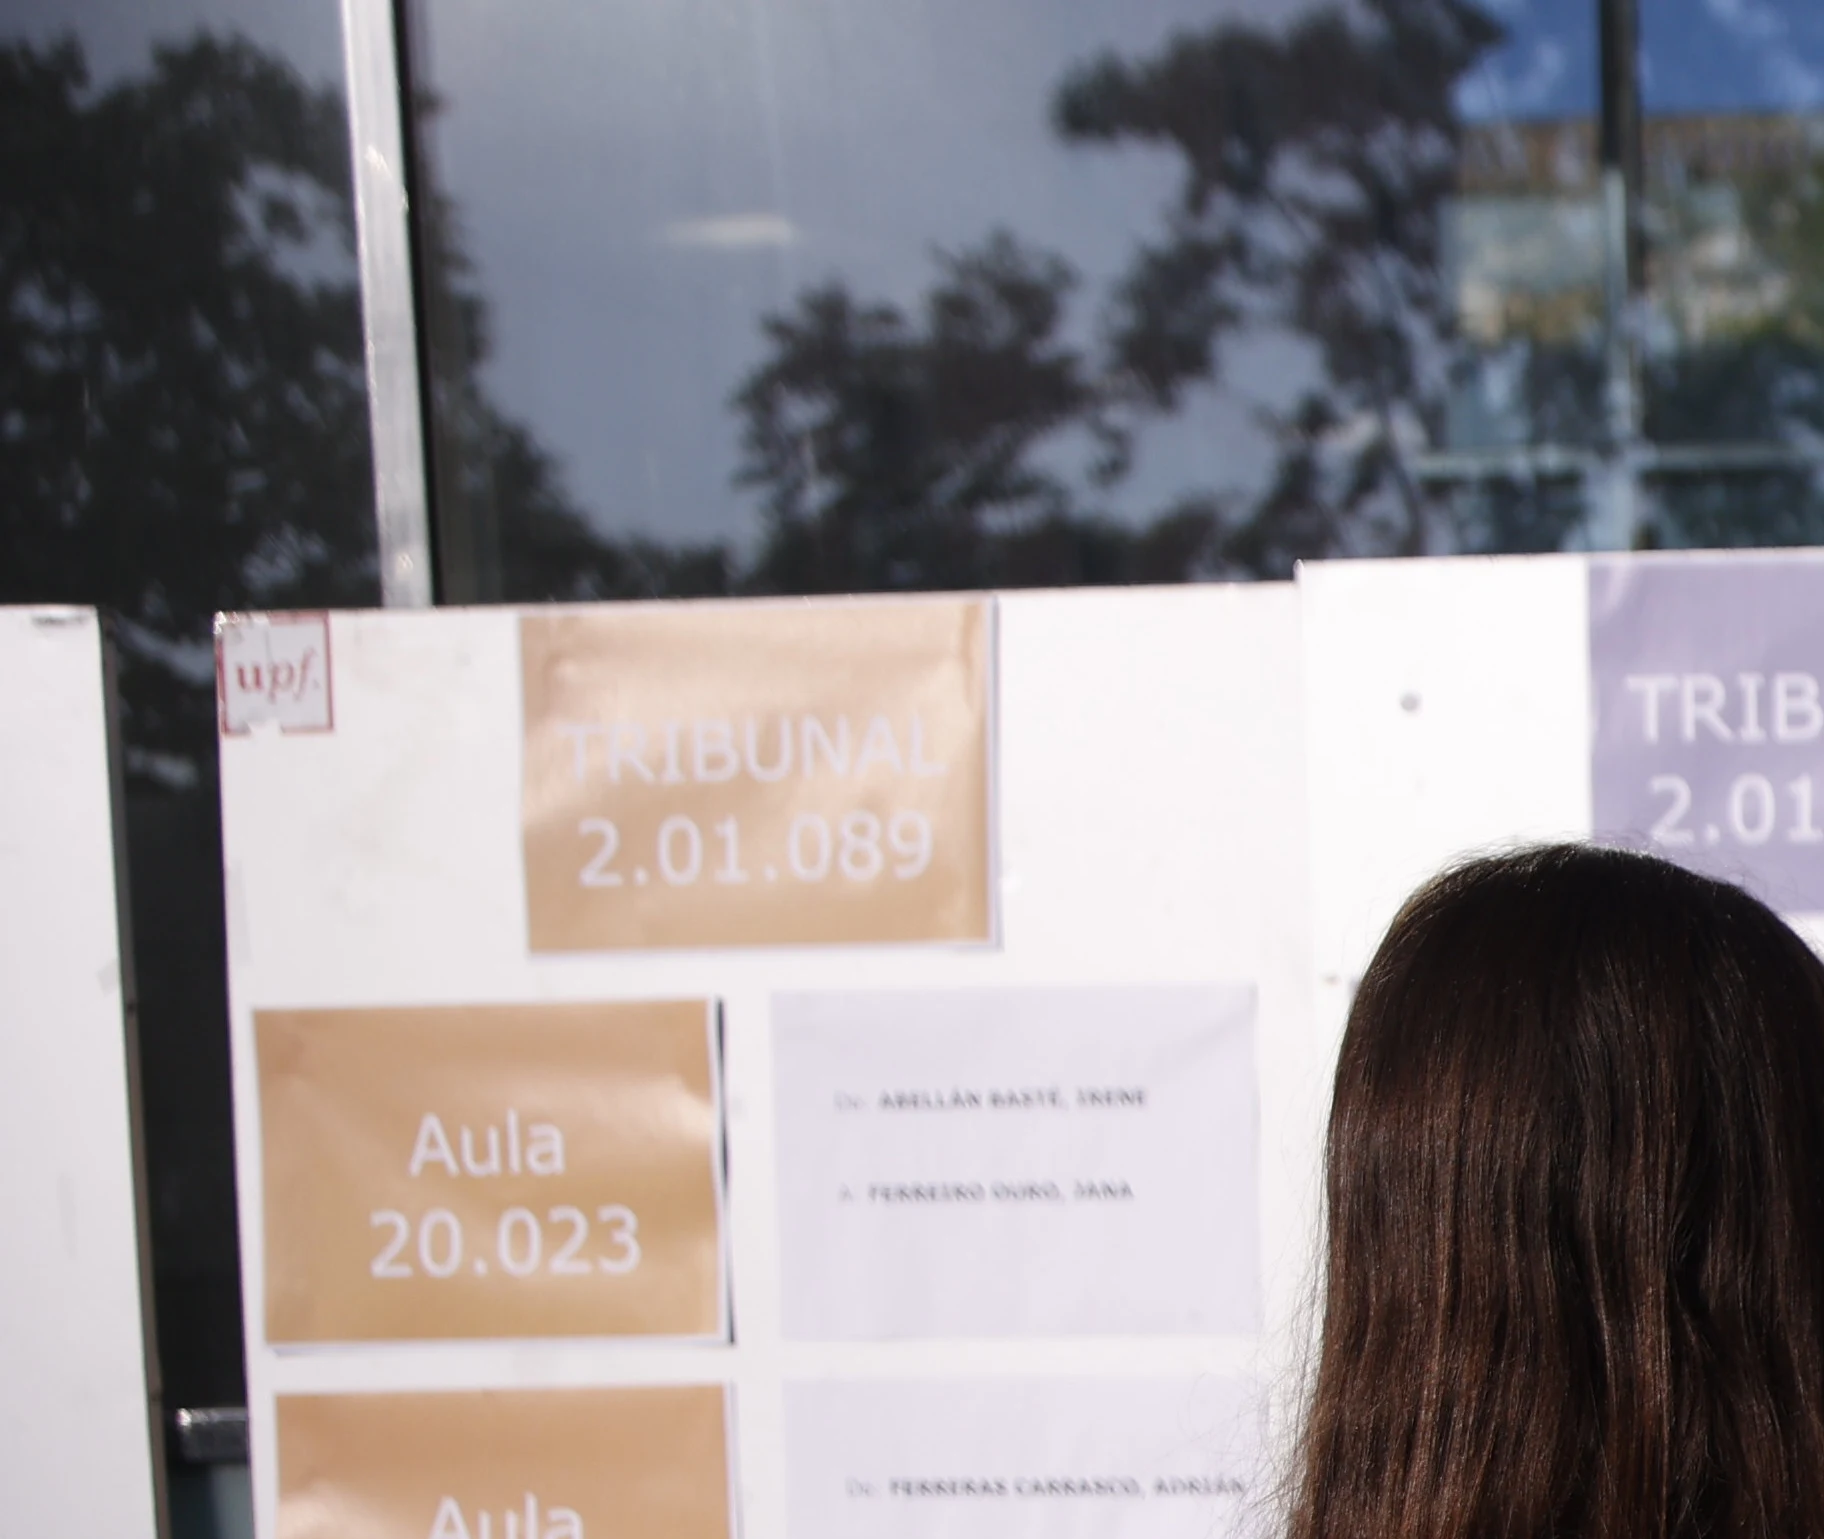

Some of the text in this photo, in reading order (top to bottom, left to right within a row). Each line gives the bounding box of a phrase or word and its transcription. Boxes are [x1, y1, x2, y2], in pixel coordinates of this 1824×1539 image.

[560, 713, 946, 784] TRIBUNAL
[577, 811, 936, 888] 2.01.089
[409, 1108, 566, 1177] Aula
[368, 1204, 642, 1279] 20.023
